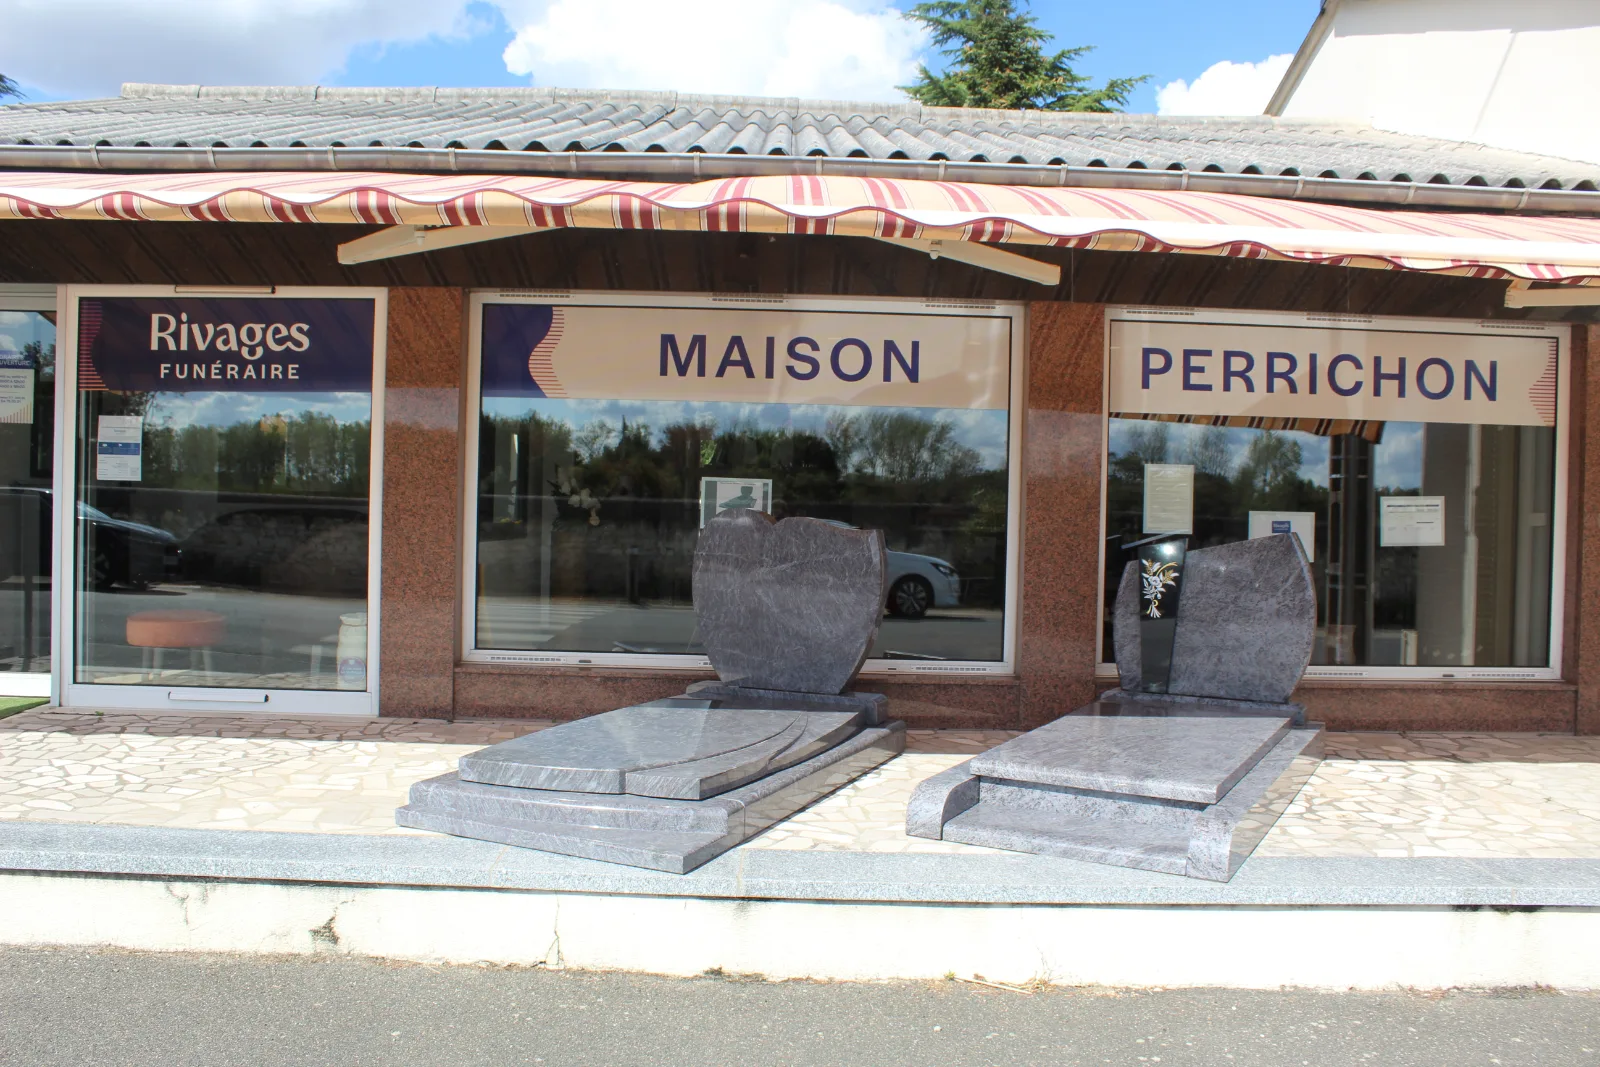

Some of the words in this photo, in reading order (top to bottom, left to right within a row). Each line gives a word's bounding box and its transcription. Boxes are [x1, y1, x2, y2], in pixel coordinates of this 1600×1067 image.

[150, 312, 310, 361] Rivages
[659, 333, 920, 384] MAISON
[159, 359, 300, 380] FUNÉRAIRE
[1141, 347, 1498, 402] PERRICHON
